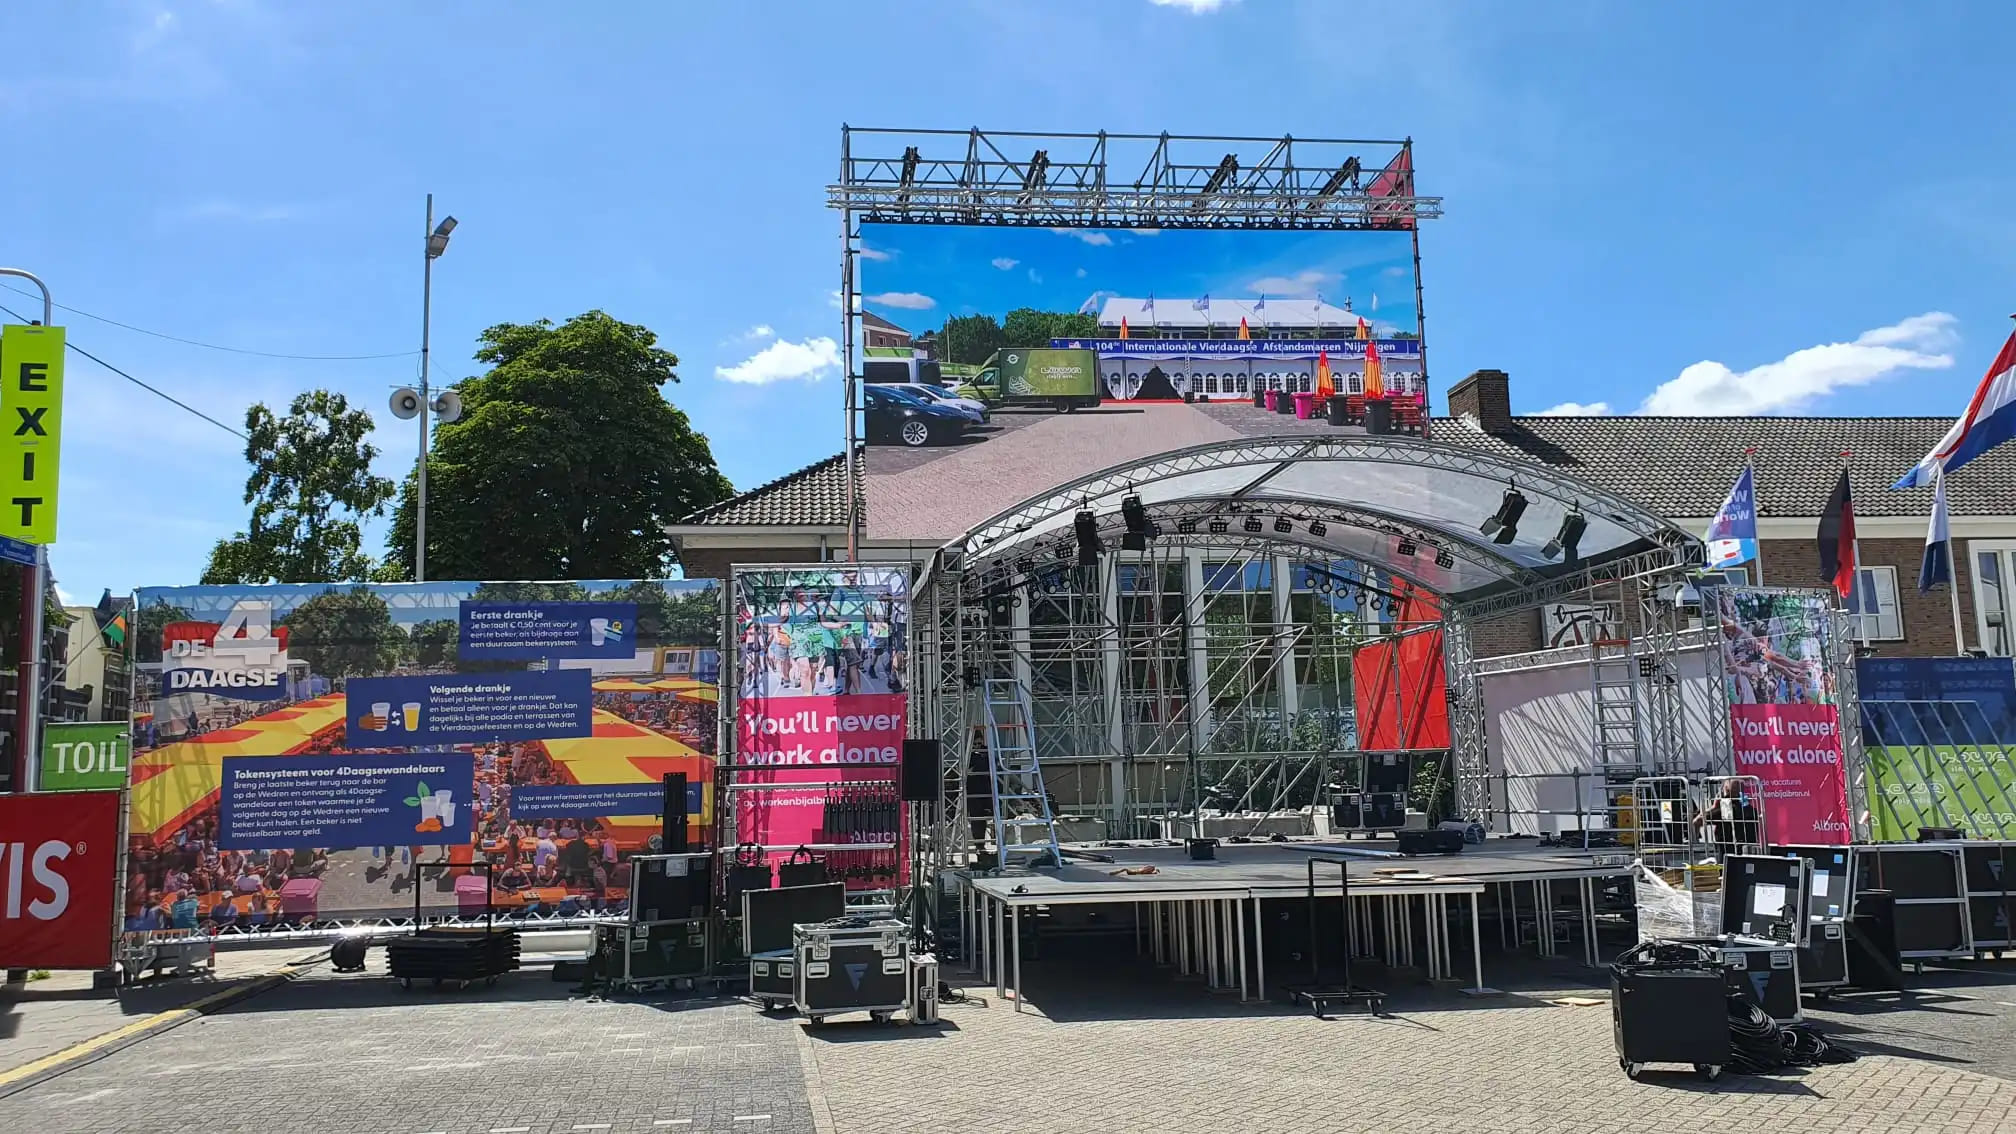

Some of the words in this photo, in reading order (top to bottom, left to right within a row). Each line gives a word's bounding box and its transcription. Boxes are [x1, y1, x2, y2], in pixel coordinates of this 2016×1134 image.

[1125, 342, 1196, 351] Internationale
[1199, 342, 1258, 353] Vierdaagse
[1262, 342, 1341, 351] Afstandsmarsen
[1345, 342, 1396, 353] Nijmgen
[12, 362, 49, 527] EXIT
[470, 610, 502, 620] Eerste
[503, 610, 544, 620] drankje
[172, 639, 206, 658] DE
[213, 600, 280, 665] 4
[486, 640, 524, 648] duurzaam
[170, 668, 279, 689] DAAGSE
[430, 685, 473, 695] Volgende
[474, 684, 511, 694] drankje
[430, 696, 454, 704] Wissel
[455, 696, 462, 704] je
[486, 694, 494, 702] in
[440, 704, 466, 712] betaal
[466, 704, 490, 712] alleen
[508, 704, 517, 712] je
[518, 702, 548, 712] drankje.
[549, 702, 562, 710] Dat
[429, 715, 463, 724] dagelijks
[464, 714, 474, 723] bij
[490, 714, 513, 722] podia
[525, 712, 560, 720] terrassen
[744, 710, 820, 735] You'll
[825, 713, 900, 733] never
[429, 724, 440, 732] de
[440, 722, 512, 732] Vierdaagsefeesten
[1735, 716, 1784, 736] You'll
[1787, 720, 1836, 736] never
[744, 743, 813, 765] work
[820, 742, 898, 764] alone
[1736, 744, 1784, 765] work
[1787, 744, 1837, 764] alone
[234, 769, 309, 780] Tokensysteem
[310, 769, 335, 777] voor
[336, 764, 446, 776] 4Daagsewandelaars
[233, 781, 257, 790] Breng
[258, 781, 266, 790] je
[267, 780, 294, 788] laatste
[319, 780, 340, 788] terug
[342, 778, 361, 786] naar
[233, 792, 244, 800] op
[258, 790, 290, 798] Wedren
[302, 789, 334, 797] ontvang
[348, 787, 387, 796] 4Daagse-
[1751, 790, 1810, 798] wekenbijalbron.nl
[232, 800, 276, 808] wandelaar
[318, 798, 356, 806] waarmee
[356, 797, 364, 806] je
[364, 796, 376, 804] de
[232, 810, 270, 820] volgende
[270, 810, 288, 818] dag
[300, 808, 312, 816] de
[361, 806, 390, 814] nieuwe
[232, 820, 255, 828] beker
[300, 818, 315, 826] Een
[1813, 820, 1847, 832] Albron
[232, 830, 281, 838] inwisselbaar
